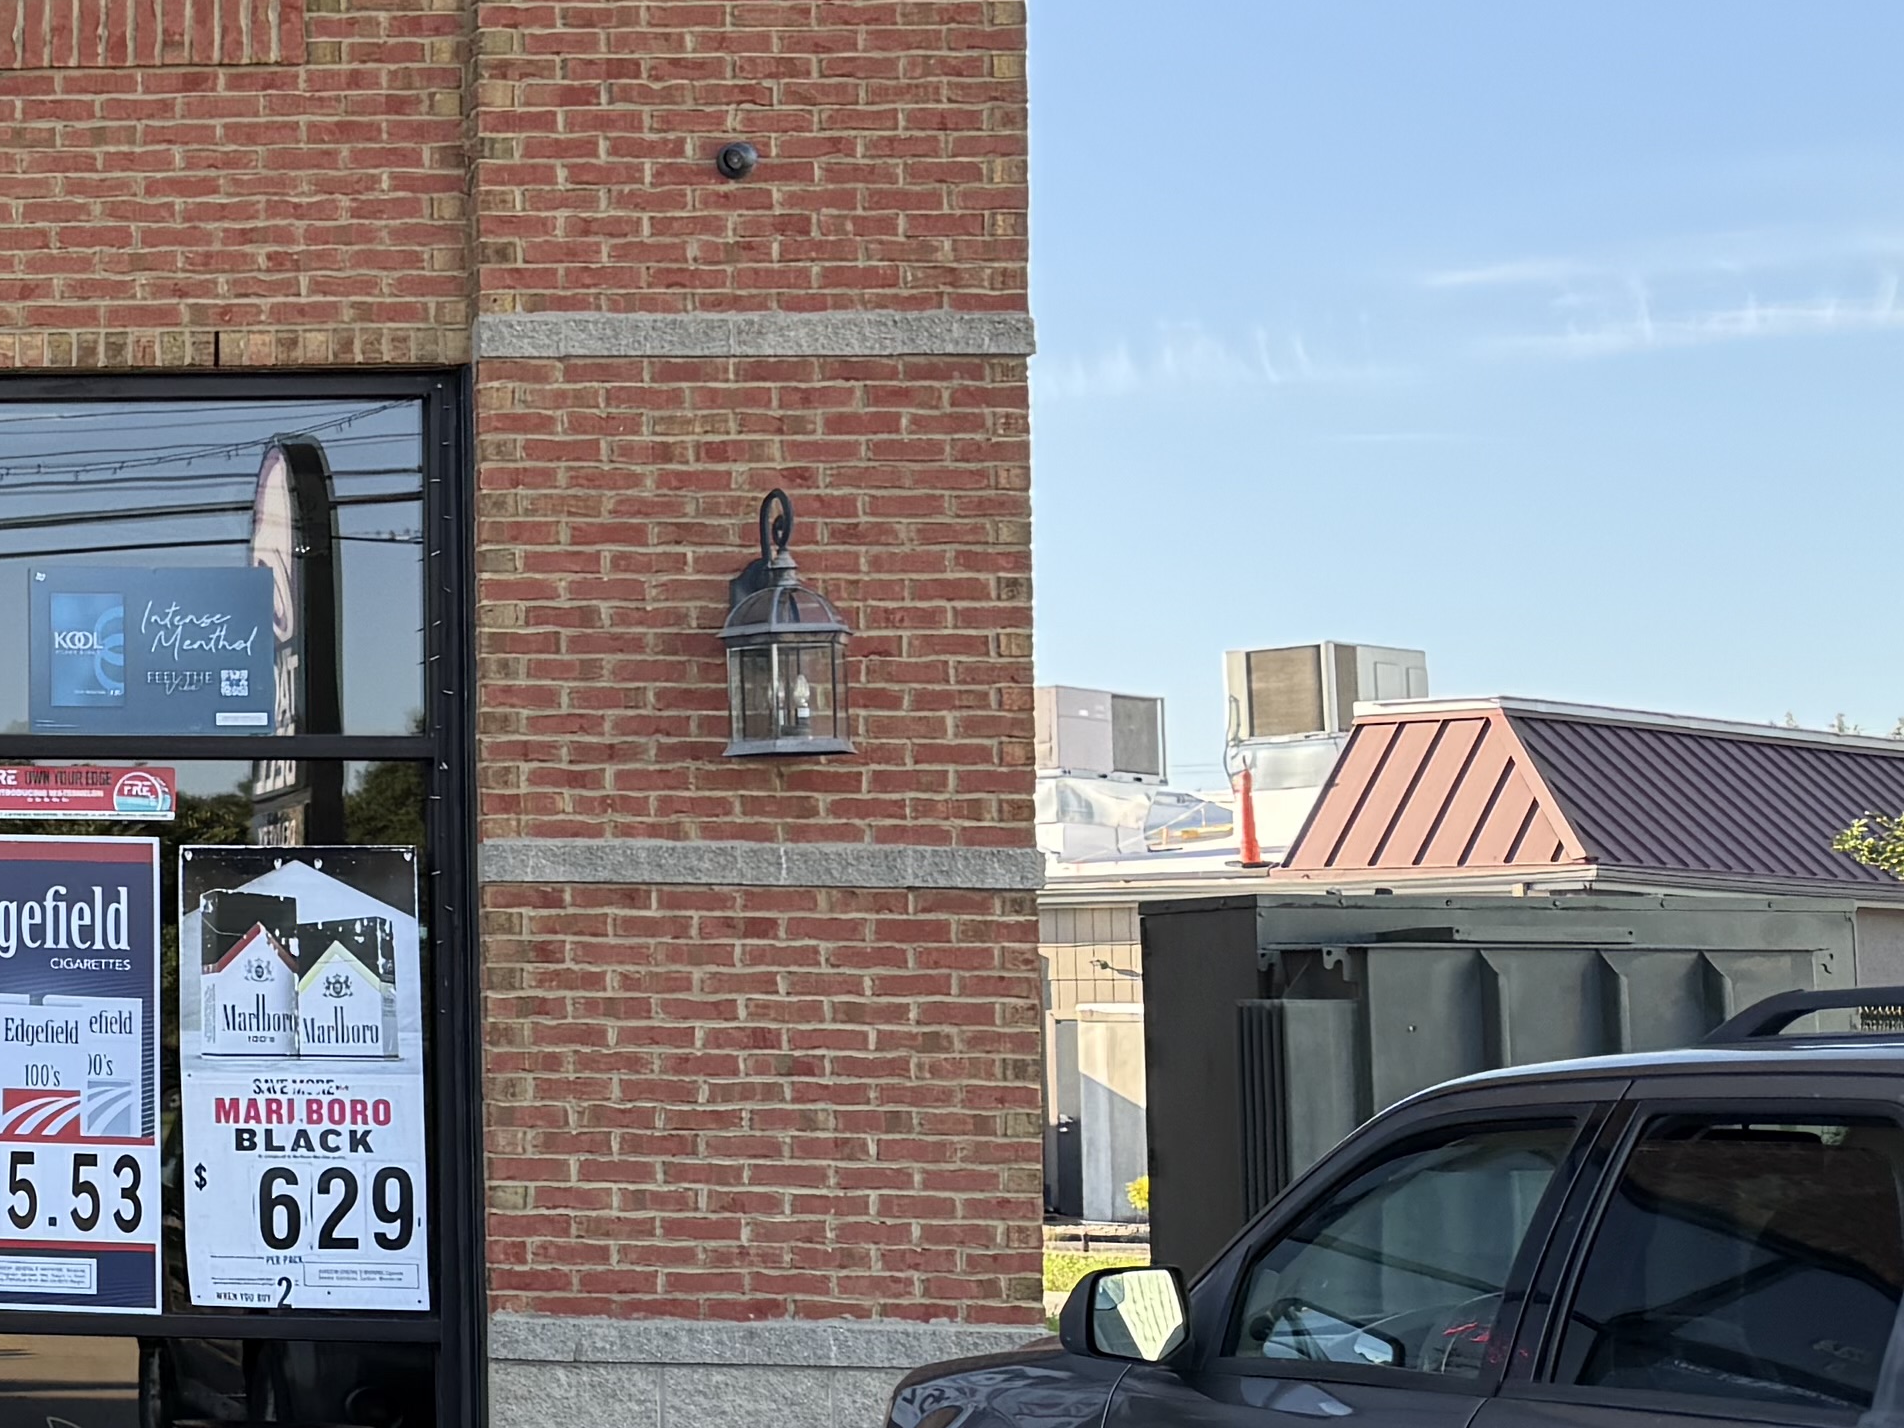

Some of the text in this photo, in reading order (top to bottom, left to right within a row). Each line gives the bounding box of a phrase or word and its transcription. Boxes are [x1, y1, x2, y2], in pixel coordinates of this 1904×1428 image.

[141, 599, 232, 634] Intense
[54, 631, 104, 649] KOOL
[151, 624, 258, 661] Menthol
[50, 957, 132, 971] CIGARETTES
[4, 1016, 80, 1047] Edgefield
[302, 1005, 380, 1045] Marlboro
[24, 1063, 61, 1087] 100's
[88, 1053, 114, 1076] 0's
[234, 1128, 374, 1153] BLACK
[7, 1150, 143, 1234] 5.53
[194, 1161, 414, 1251] $ 629
